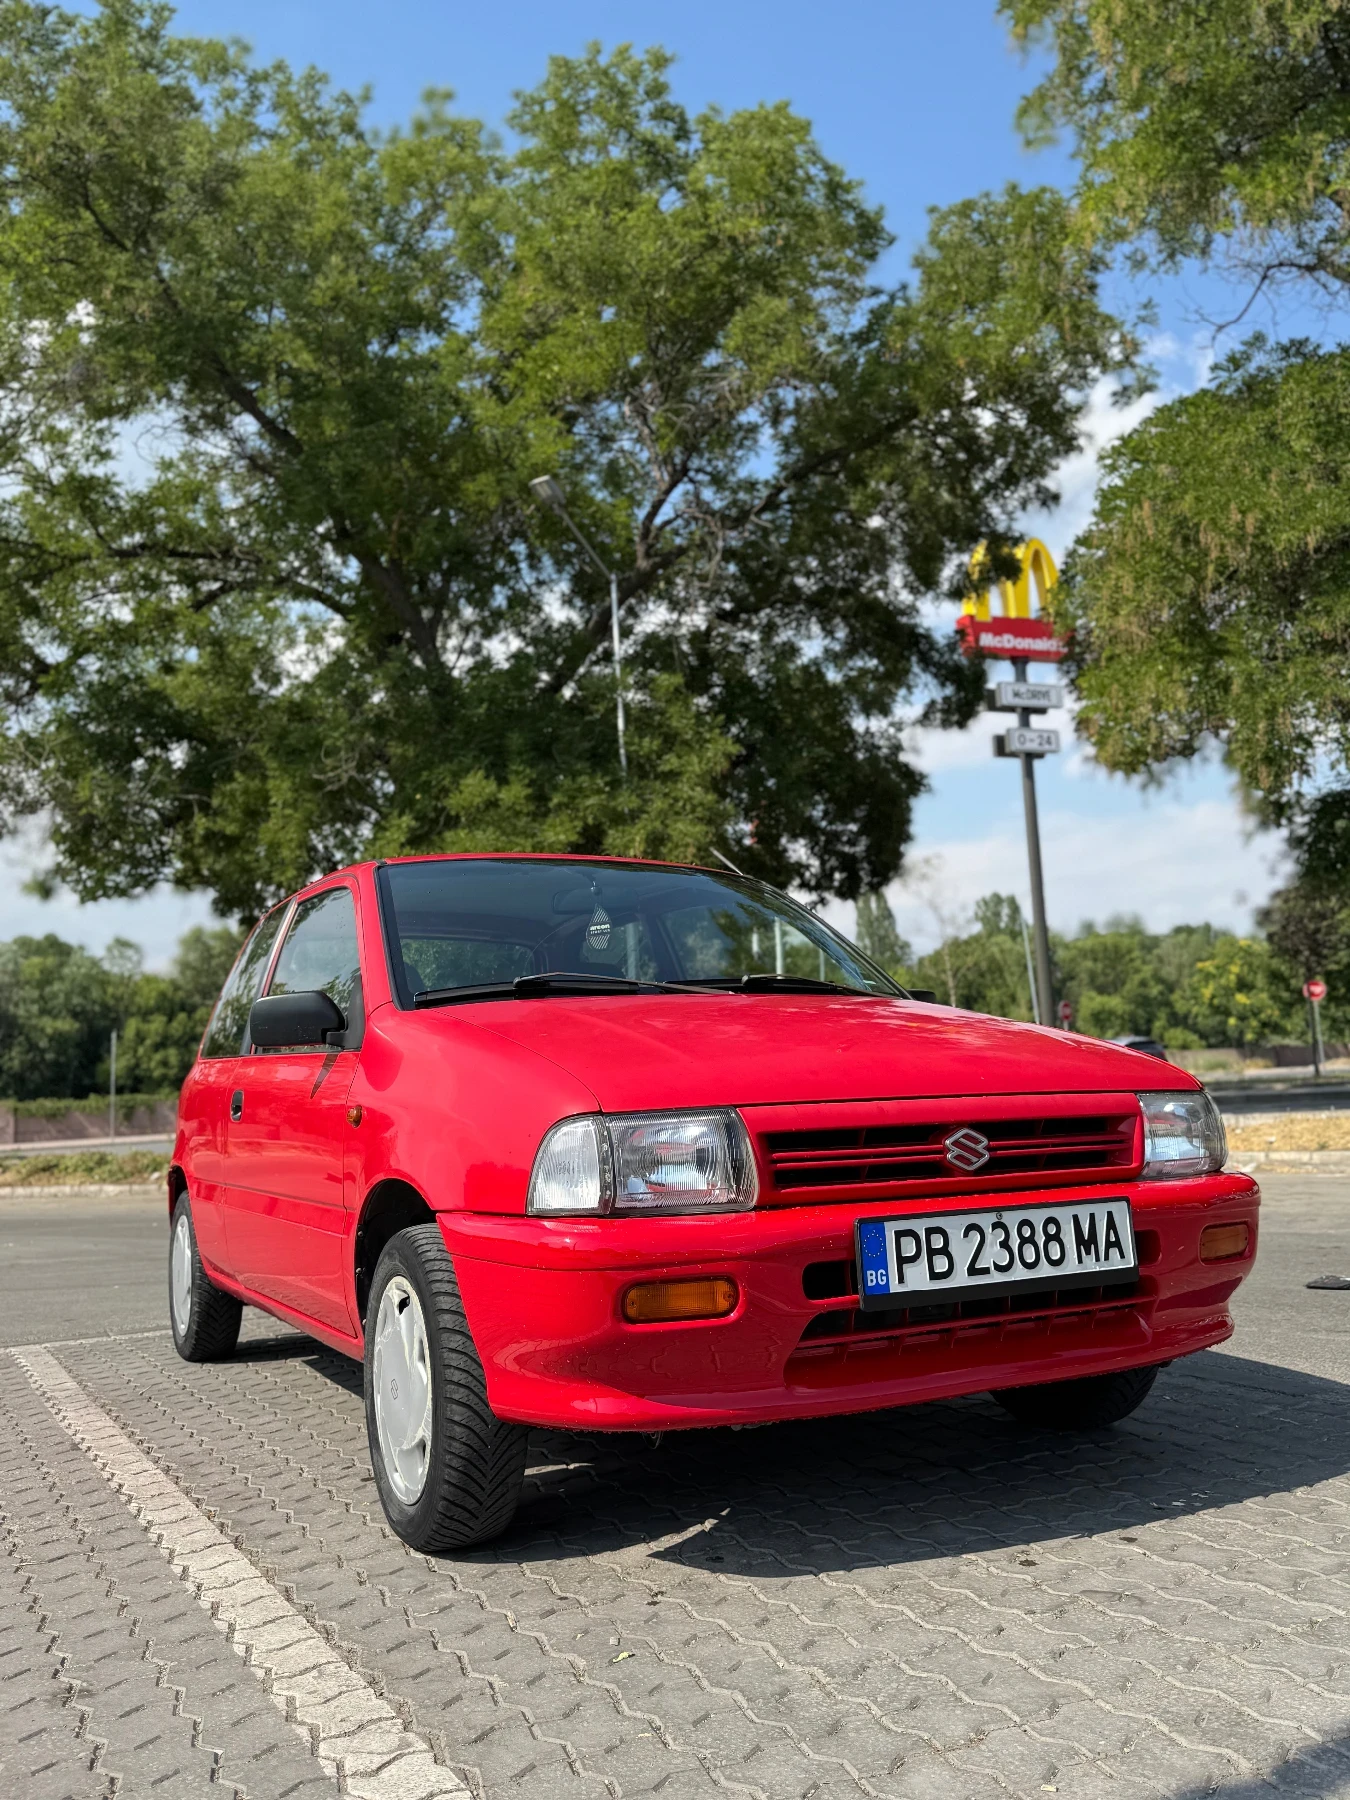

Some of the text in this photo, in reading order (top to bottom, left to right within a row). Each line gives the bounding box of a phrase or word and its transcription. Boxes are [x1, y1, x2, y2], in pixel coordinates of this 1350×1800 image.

[979, 632, 1069, 653] McDonalds
[893, 1210, 1126, 1284] PB 2388 MA
[866, 1269, 887, 1287] BG
